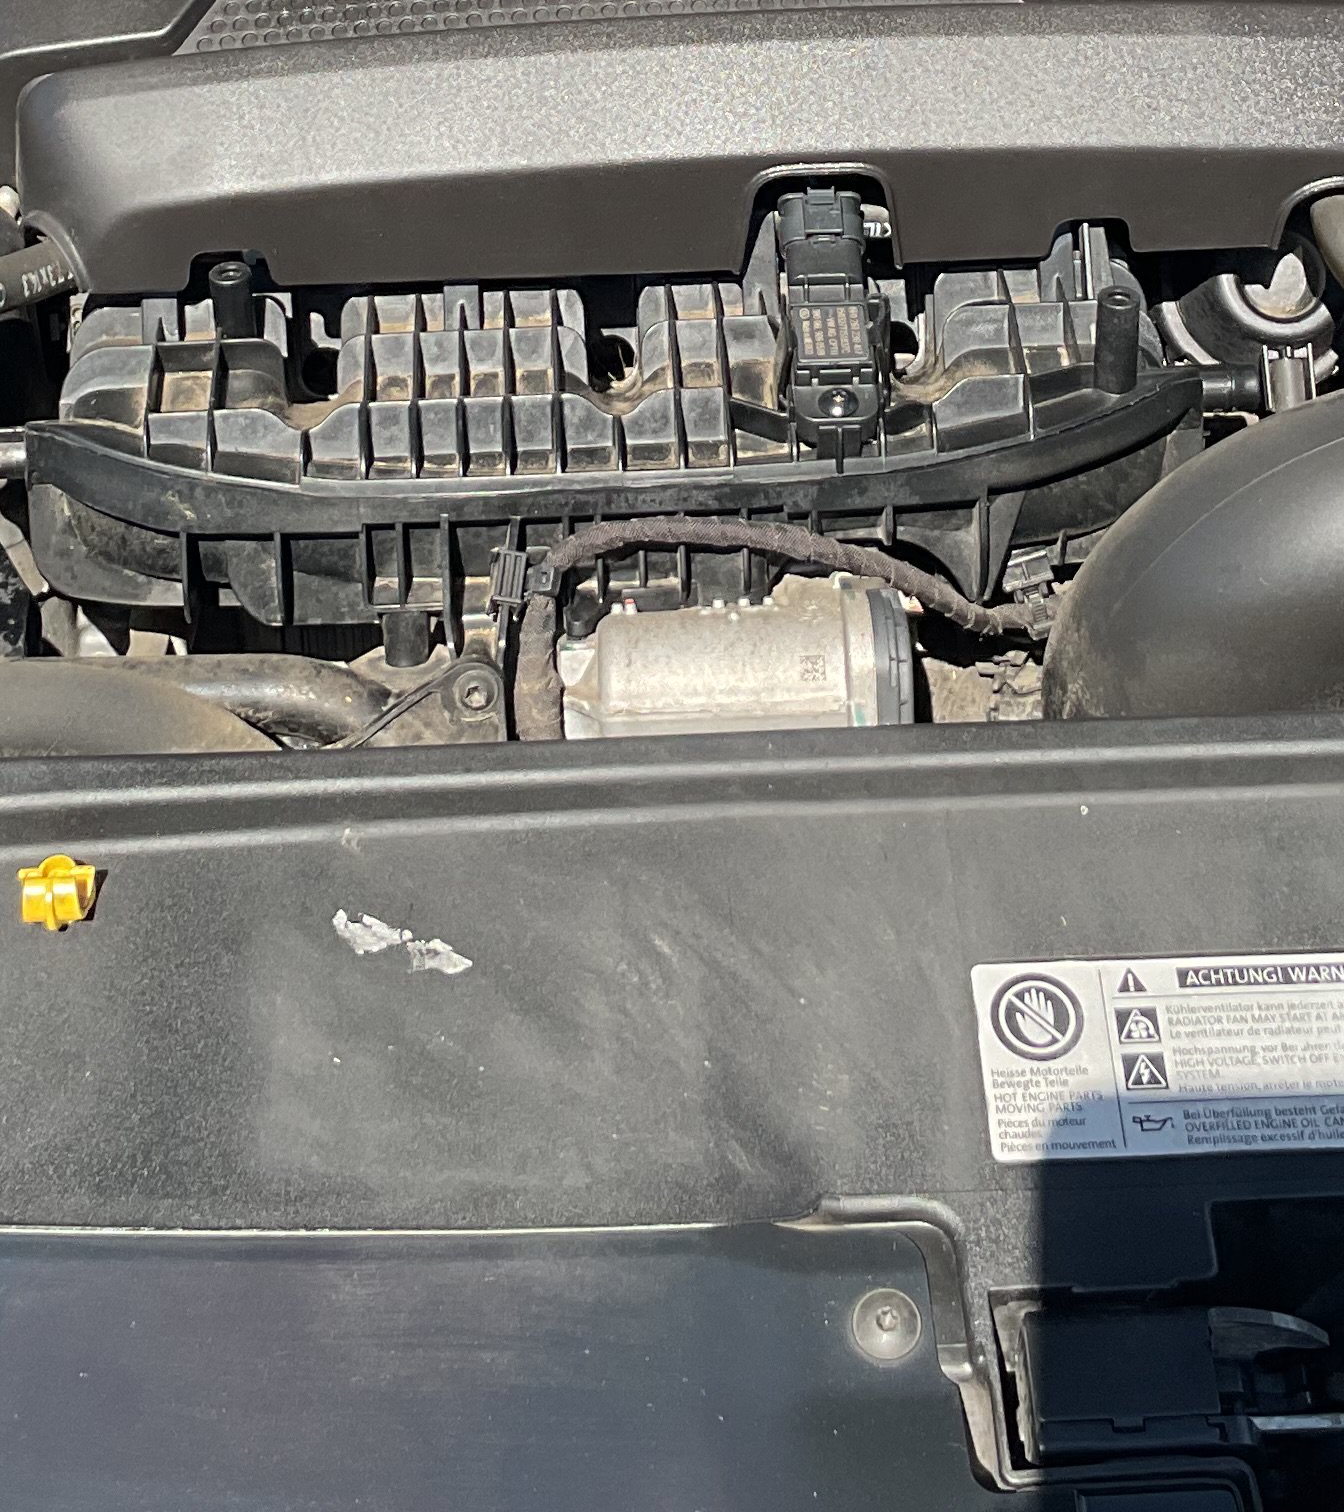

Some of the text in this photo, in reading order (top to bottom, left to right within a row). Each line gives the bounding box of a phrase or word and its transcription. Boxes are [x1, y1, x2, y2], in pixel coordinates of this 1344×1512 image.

[1186, 966, 1284, 986] ACHTUNG!
[1257, 999, 1284, 1012] kann
[1168, 1014, 1223, 1027] RADIATOR
[1226, 1013, 1249, 1025] FAN
[1251, 1012, 1277, 1024] MAY
[1170, 1028, 1181, 1039] Le
[1184, 1026, 1244, 1039] ventilateur
[1247, 1025, 1261, 1036] de
[1263, 1023, 1313, 1036] radiateur
[1261, 1044, 1278, 1054] vor
[1175, 1057, 1205, 1069] HIGH
[1263, 1052, 1306, 1065] SWITCH
[1309, 1051, 1329, 1064] OFF
[991, 1065, 1089, 1078] Heisse Motorteile
[992, 1077, 1069, 1091] Bewegte Teile
[994, 1090, 1104, 1103] HOT ENGINE PARTS
[996, 1103, 1045, 1114] MOVING
[1183, 1108, 1201, 1120] Bei
[1275, 1105, 1316, 1117] besteht
[998, 1117, 1087, 1128] Pièces du moteur
[1185, 1120, 1251, 1133] OVERFILLED
[1255, 1118, 1298, 1130] ENGINE
[1300, 1116, 1320, 1128] OIL
[1001, 1138, 1116, 1152] Pièces en mouvement
[1188, 1133, 1256, 1147] Remplissage
[1261, 1130, 1305, 1142] excessif
